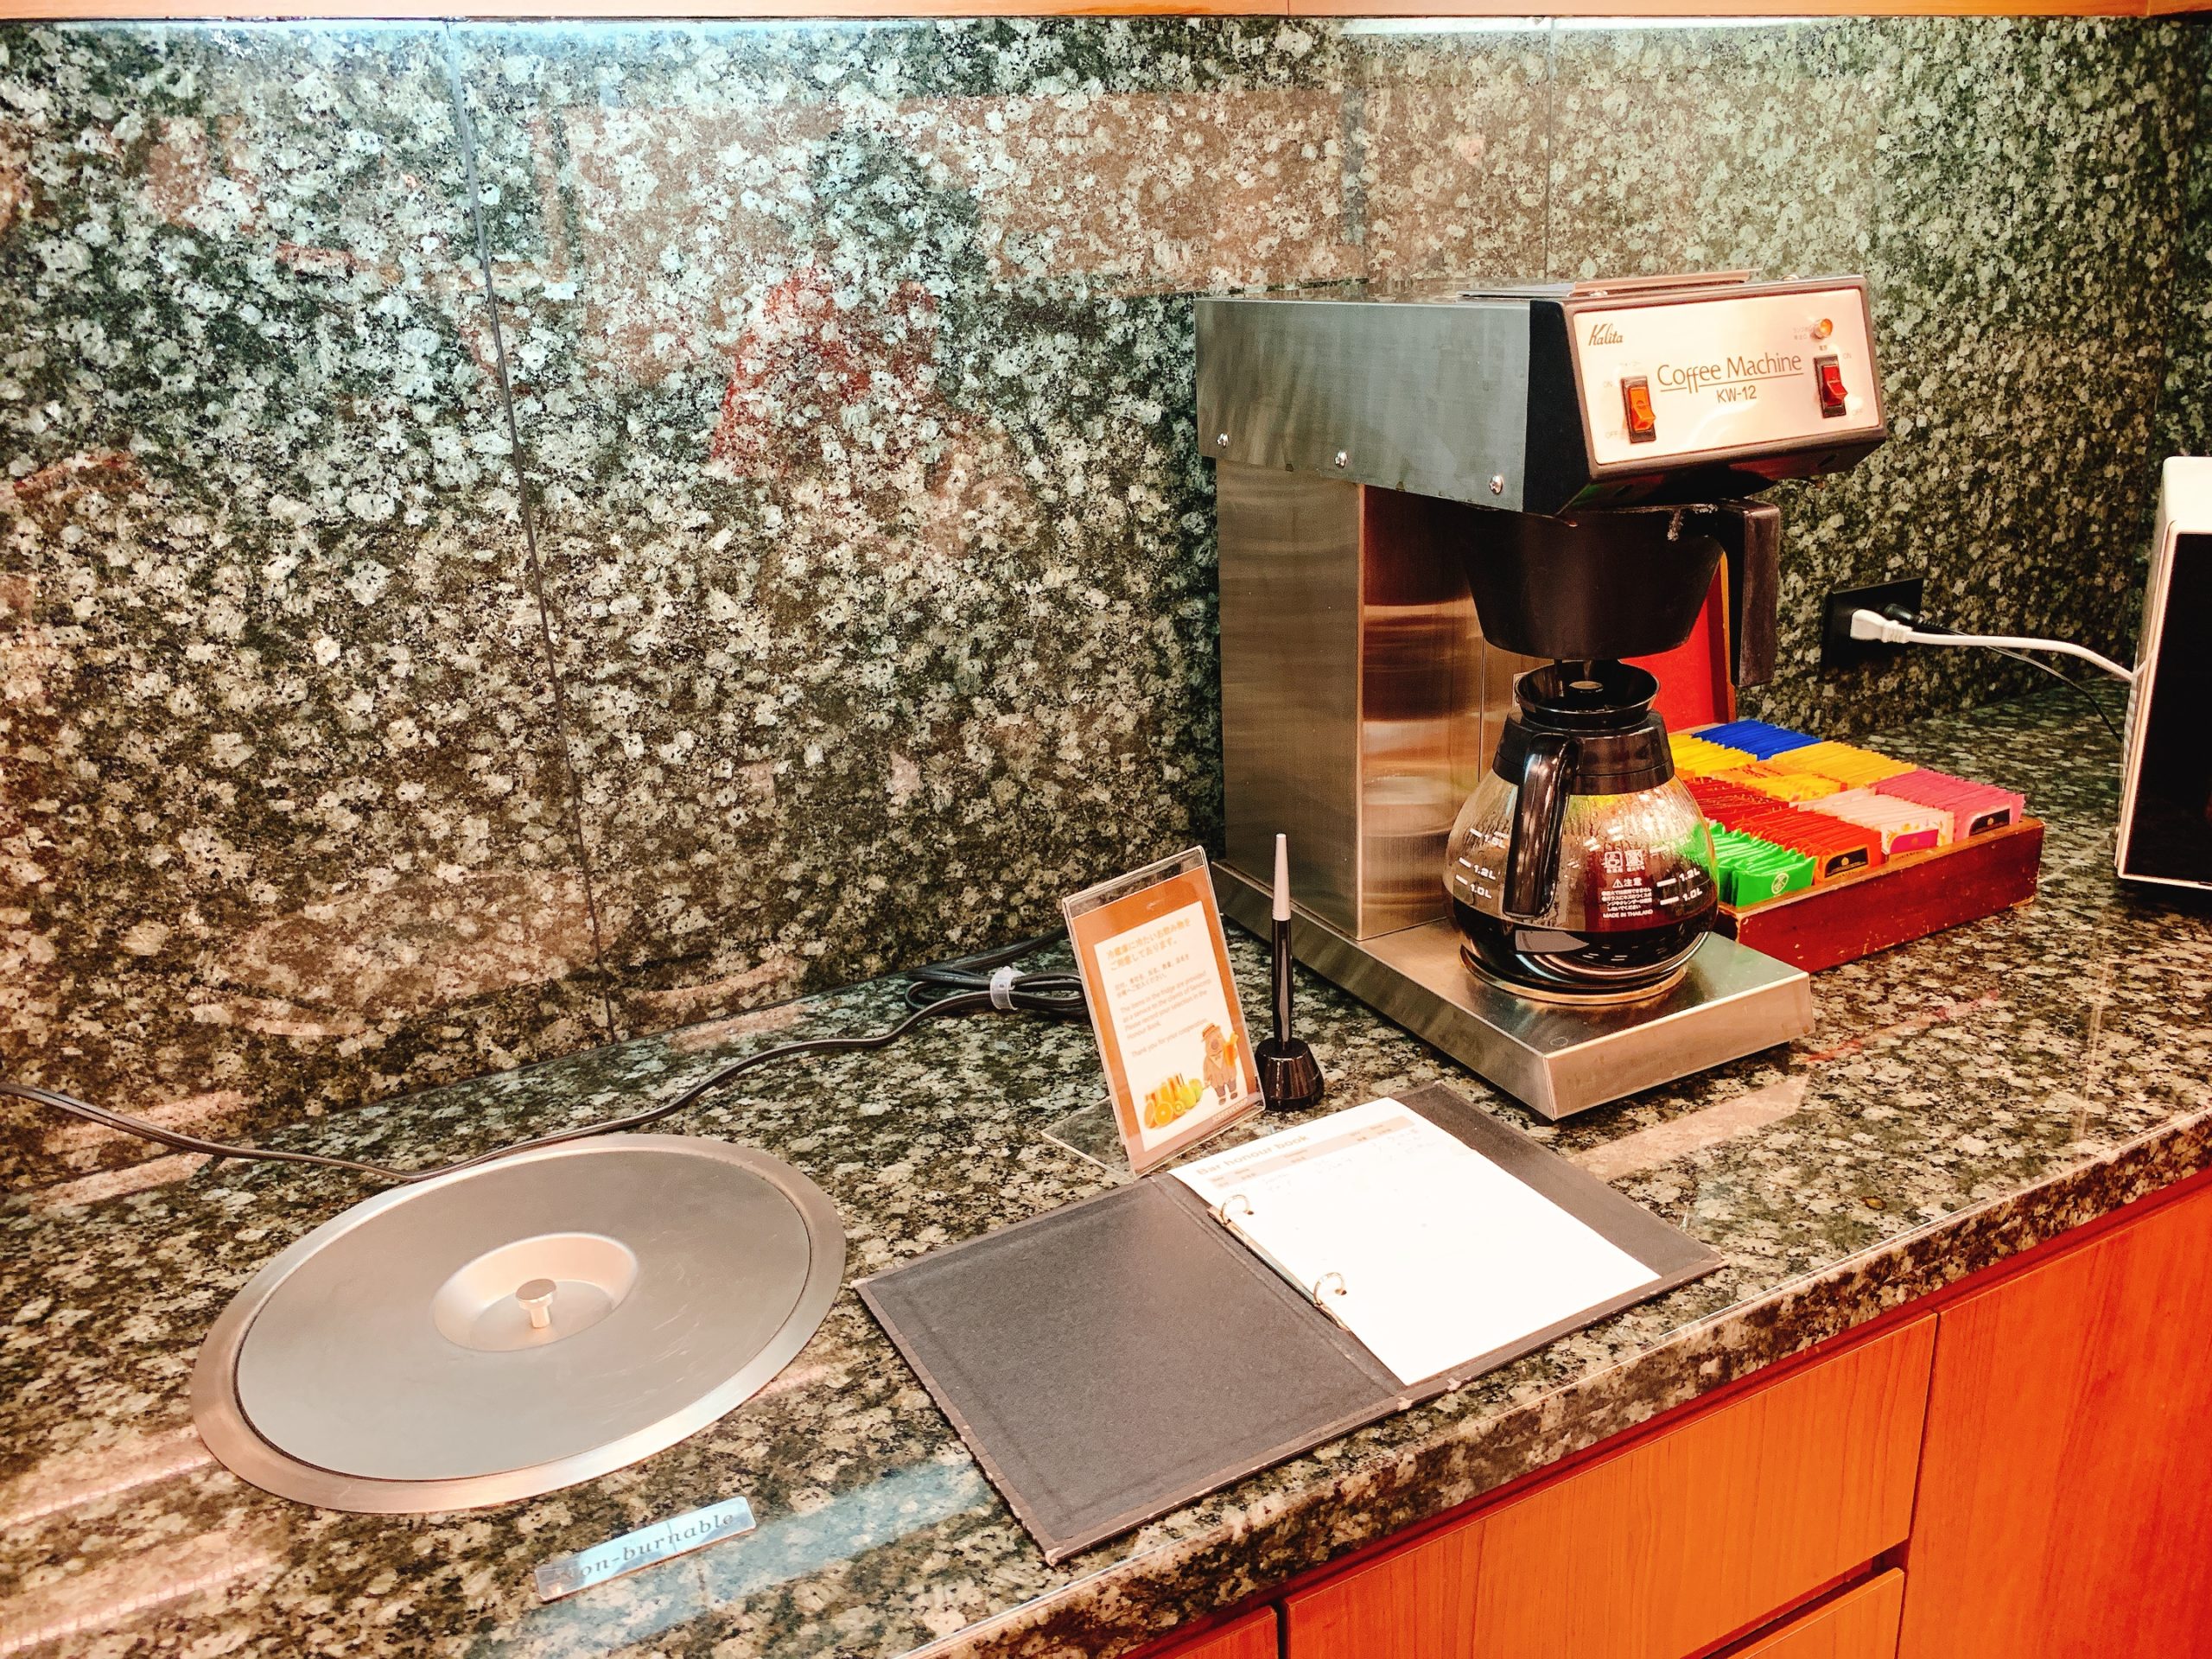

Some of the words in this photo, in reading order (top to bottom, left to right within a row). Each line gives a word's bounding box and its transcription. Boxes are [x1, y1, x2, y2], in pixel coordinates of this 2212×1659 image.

[1588, 323, 1624, 346] Kalita
[1656, 363, 1721, 394] Coffee
[1727, 352, 1802, 378] Machine
[1716, 385, 1758, 404] KW-12
[1473, 864, 1497, 880] 1.2L
[1679, 868, 1700, 881] 1.2L
[1470, 883, 1492, 899] 1.0L
[1682, 887, 1703, 901] 1.0L
[562, 1513, 734, 1580] on-burnable
